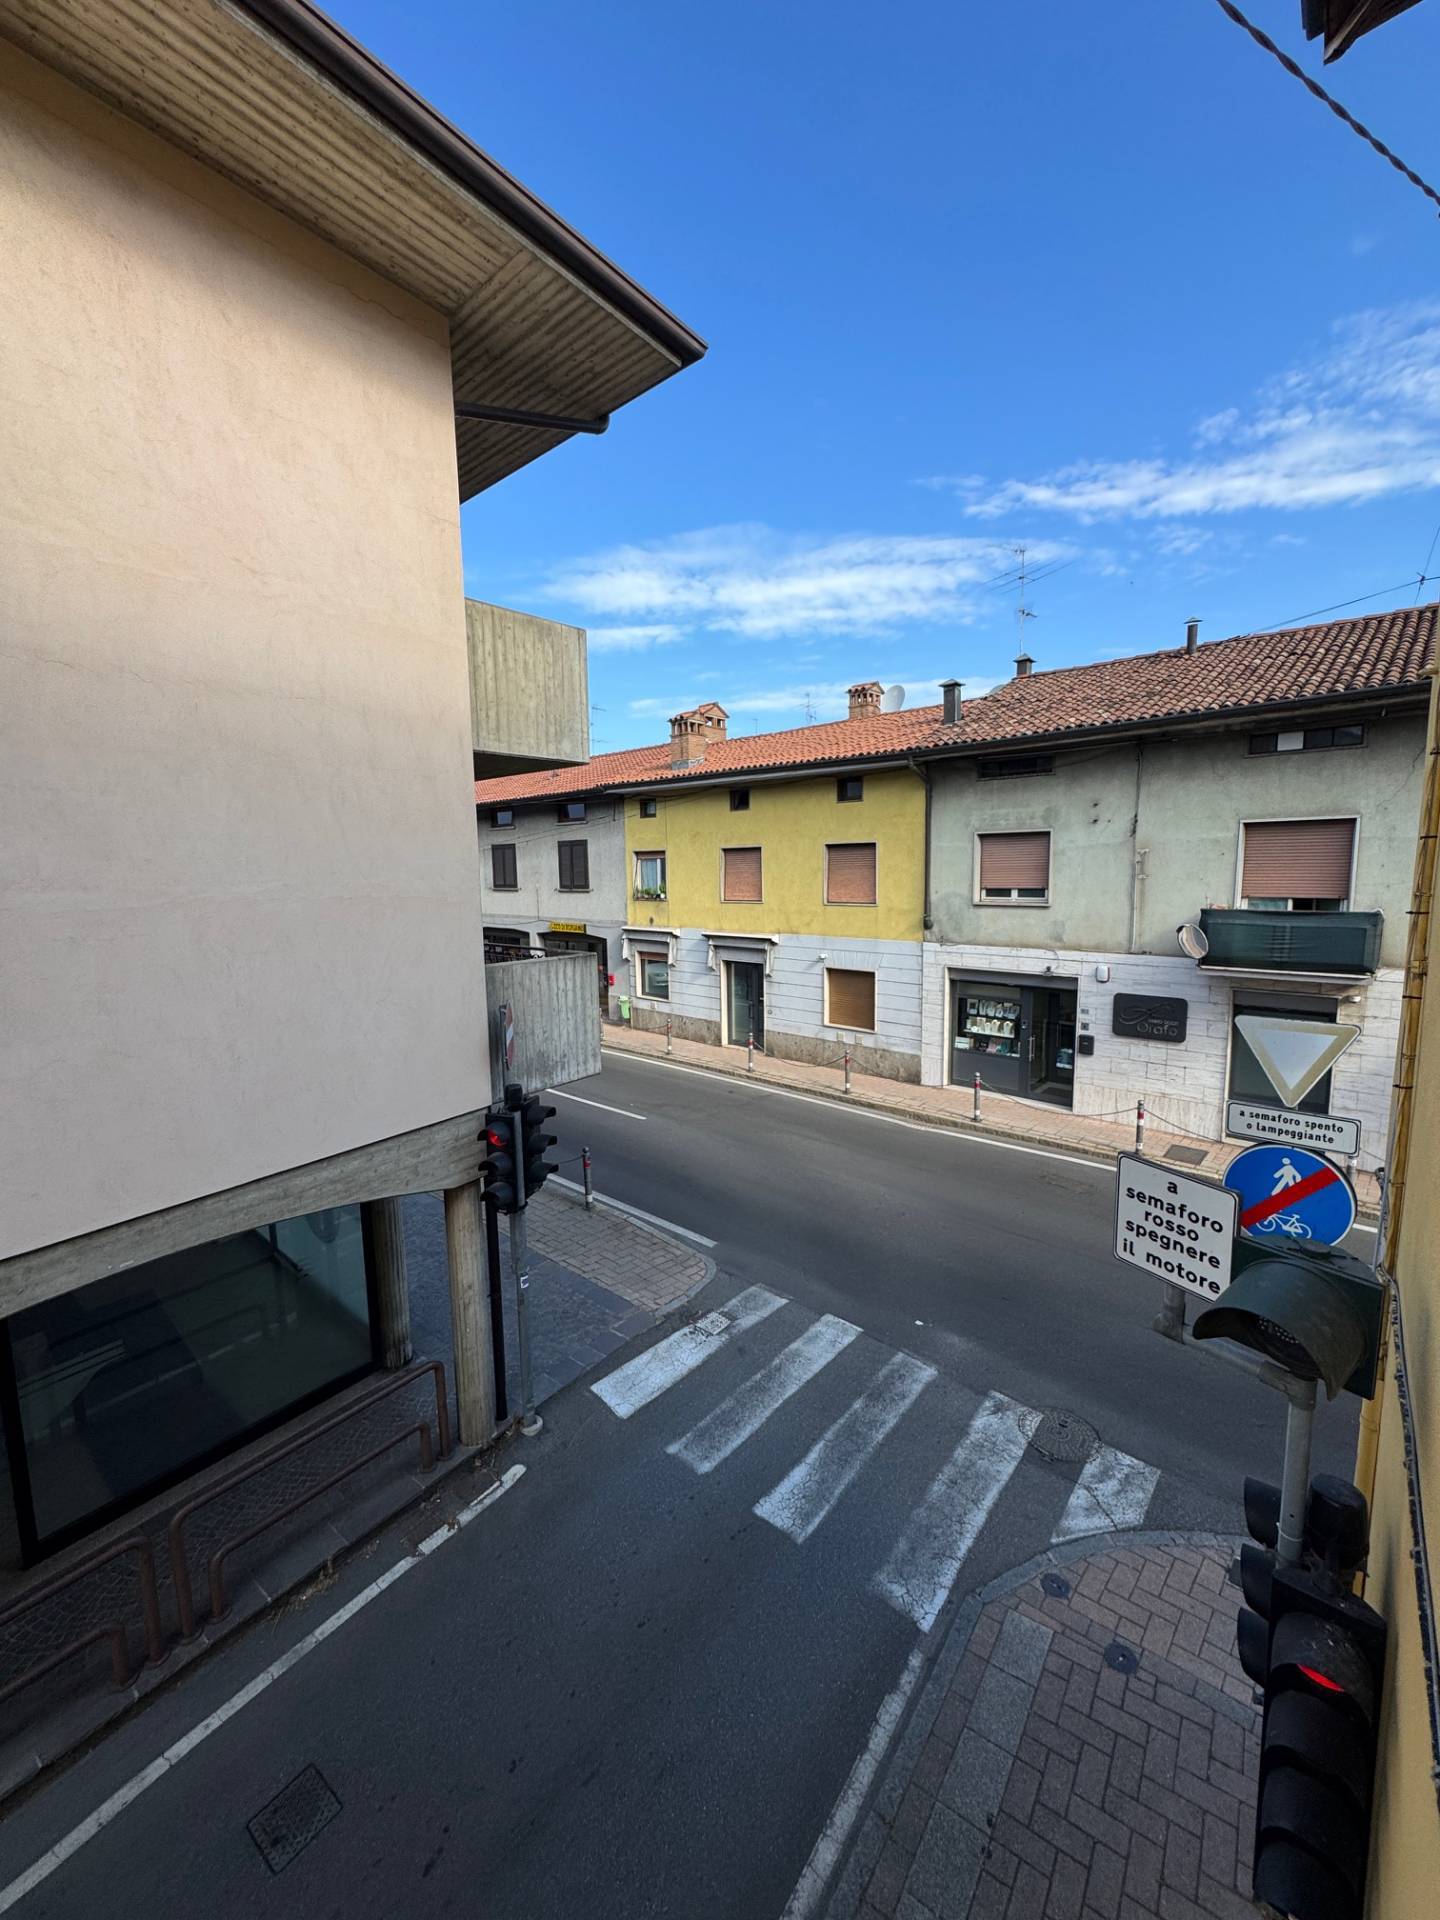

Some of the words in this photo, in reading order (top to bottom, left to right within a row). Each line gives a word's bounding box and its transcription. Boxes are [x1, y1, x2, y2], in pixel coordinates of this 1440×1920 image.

[1137, 1022, 1178, 1037] Orafo
[1249, 1111, 1301, 1126] semaforo
[1304, 1120, 1344, 1133] spento
[1256, 1122, 1334, 1144] lampeggiante
[1167, 1181, 1178, 1195] a
[1126, 1187, 1223, 1233] semaforo
[1144, 1210, 1199, 1241] rosso
[1125, 1220, 1221, 1269] spegnere
[1123, 1237, 1135, 1257] il
[1146, 1251, 1221, 1295] motore
